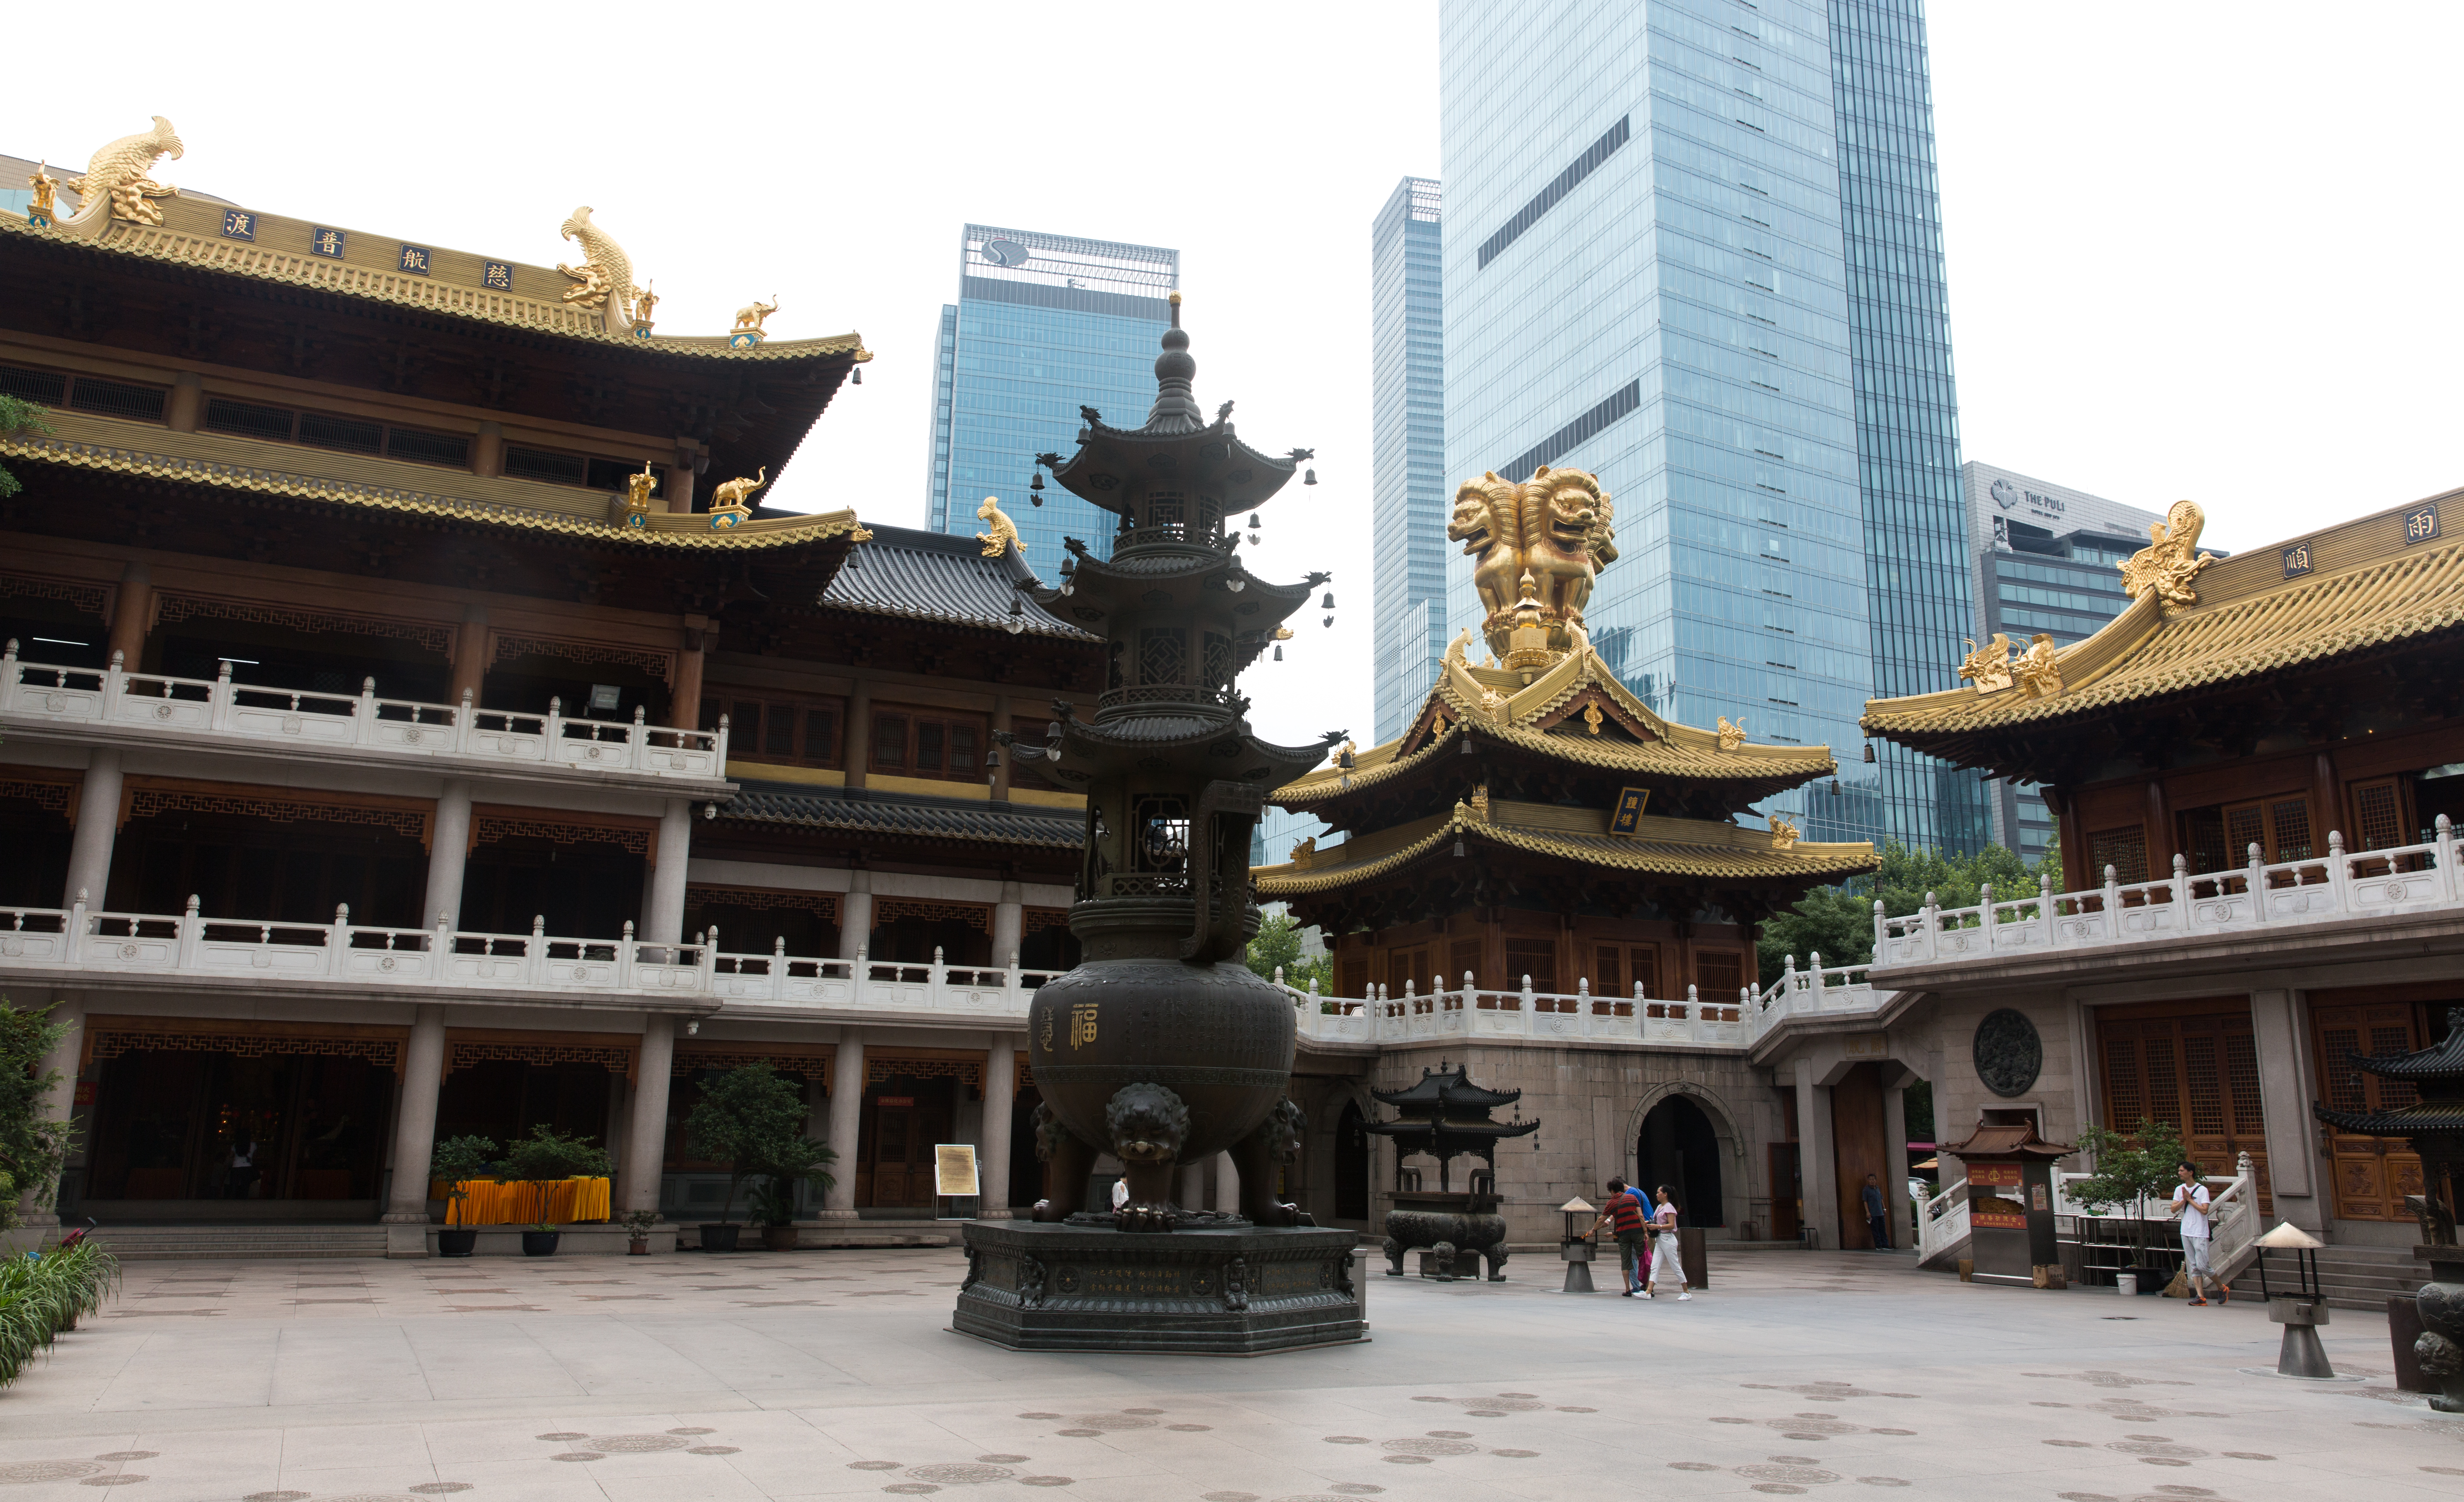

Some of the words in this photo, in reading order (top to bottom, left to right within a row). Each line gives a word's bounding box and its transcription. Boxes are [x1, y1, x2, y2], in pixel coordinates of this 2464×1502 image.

[2024, 491, 2043, 506] THE
[2044, 496, 2065, 512] PULI
[2408, 510, 2434, 537] 雨
[2285, 545, 2310, 570] 順
[1070, 1003, 1099, 1051] 福
